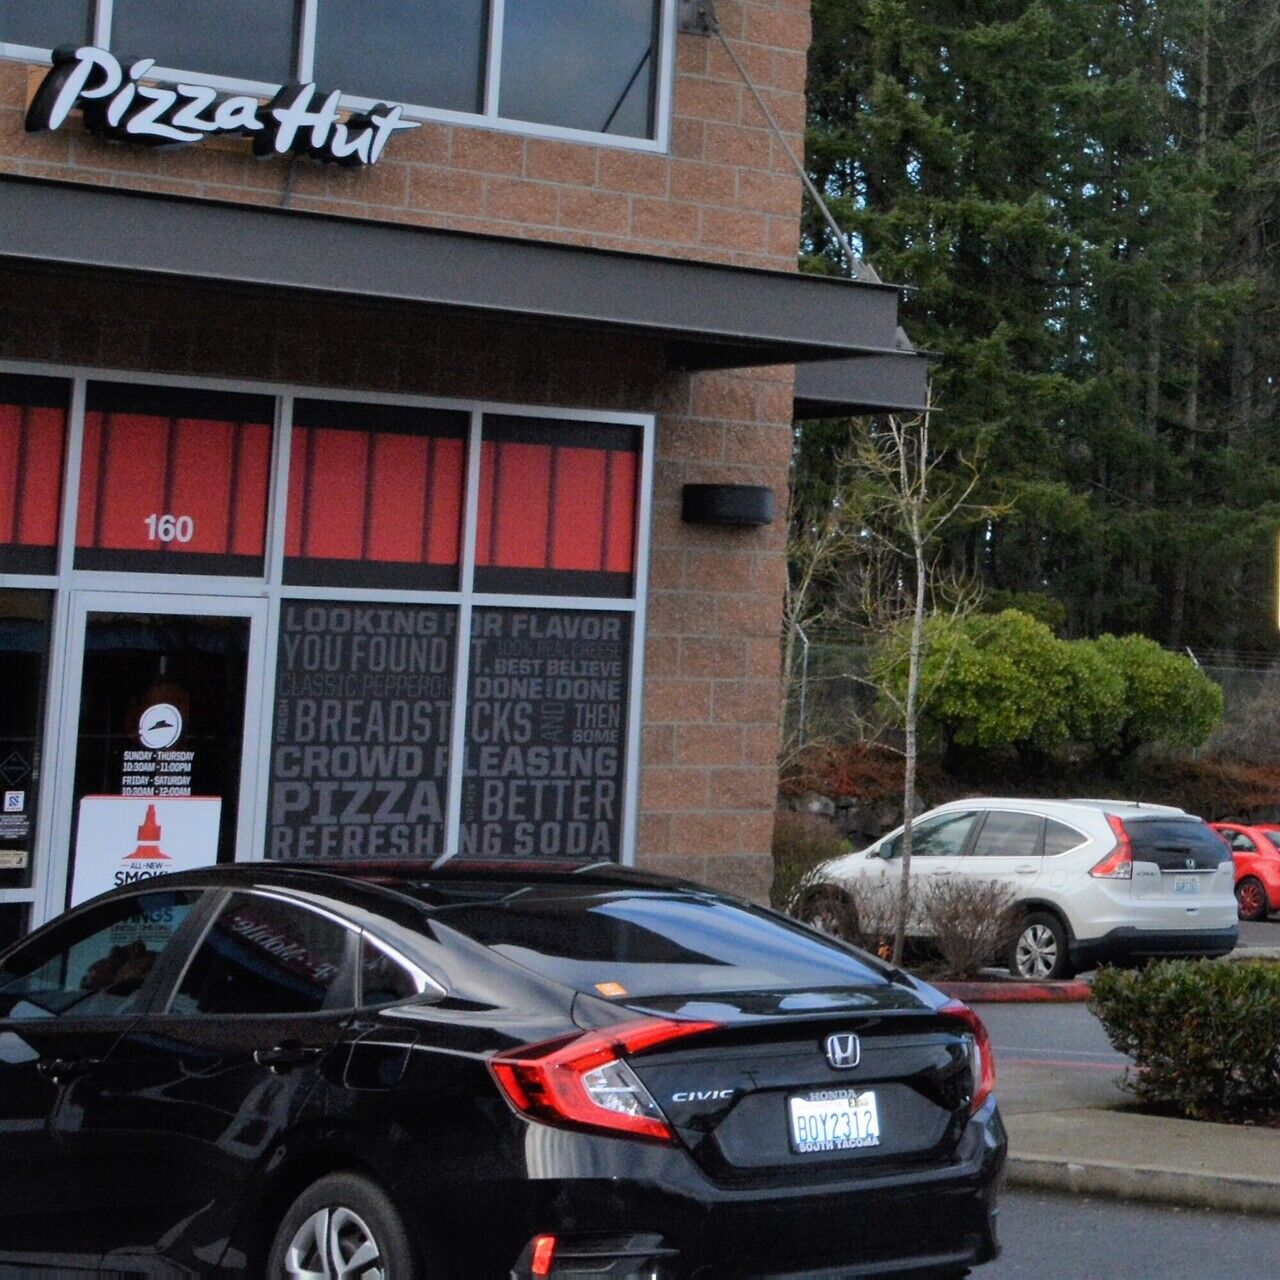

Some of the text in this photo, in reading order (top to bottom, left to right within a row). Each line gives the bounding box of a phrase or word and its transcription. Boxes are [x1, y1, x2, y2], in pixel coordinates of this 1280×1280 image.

[49, 46, 422, 165] Pizza Hut
[144, 513, 194, 542] 160
[285, 606, 438, 635] LOOKING
[511, 614, 621, 640] FLAVOR
[282, 634, 489, 674] YOU FOUND T.
[495, 658, 621, 677] BEST BELIEVE
[279, 672, 356, 697] CLASSIC
[474, 676, 543, 699] DONE
[555, 678, 621, 700] DONE
[294, 698, 532, 744] BREADSTCKS
[574, 702, 620, 728] THEN
[572, 728, 619, 743] SOME
[122, 762, 155, 772] 10:30AM
[123, 751, 152, 761] SUNDAY
[157, 751, 195, 761] THURSDAY
[274, 745, 423, 778] CROWD
[122, 776, 150, 786] FRIDAY
[154, 776, 191, 786] SATURDAY
[272, 780, 443, 825] PIZZA
[482, 779, 616, 821] BETTER
[271, 820, 612, 859] REFRESHNG SODA
[130, 861, 164, 870] ALL-NEW
[672, 1089, 734, 1102] CIVIC
[809, 1089, 858, 1102] HONDA
[799, 1134, 880, 1154] SOUTH TACOMA
